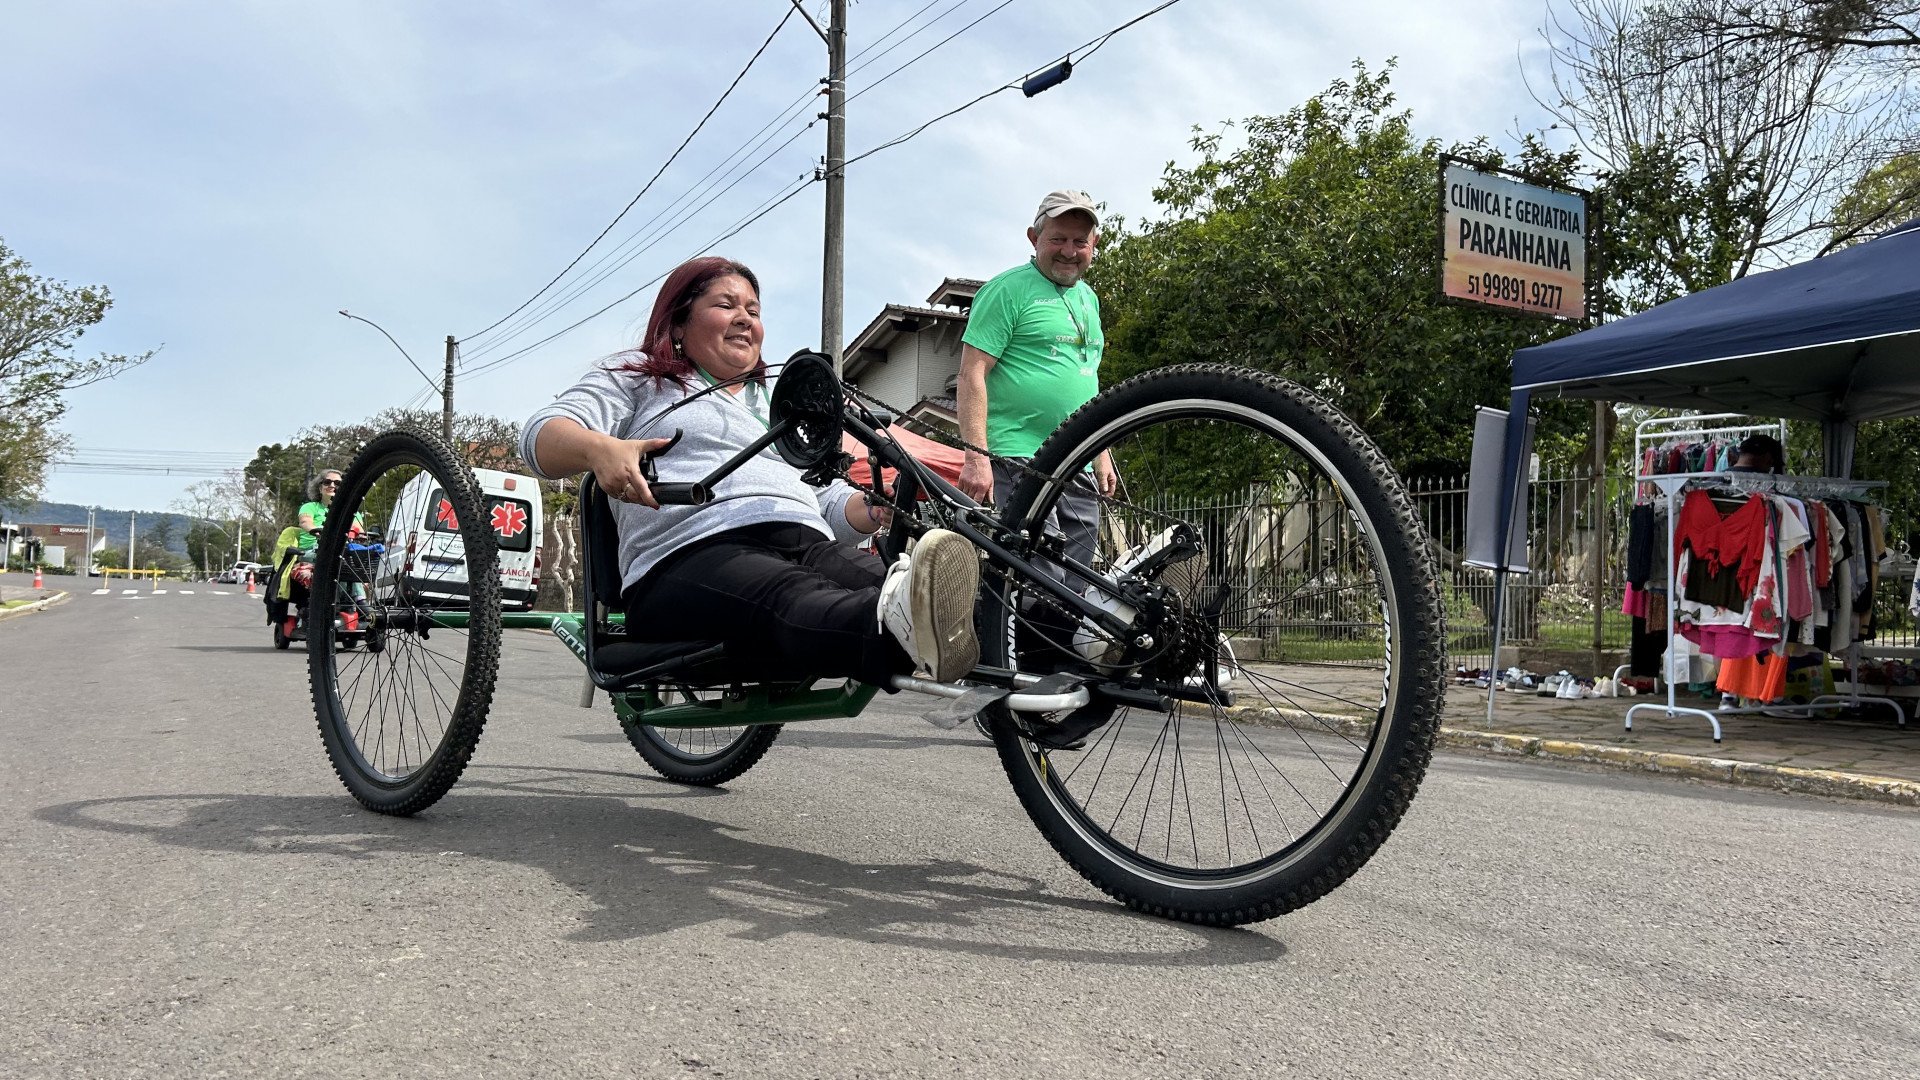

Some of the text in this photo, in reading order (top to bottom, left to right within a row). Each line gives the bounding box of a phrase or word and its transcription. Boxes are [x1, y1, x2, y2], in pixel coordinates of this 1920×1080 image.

[1451, 183, 1580, 235] CLÍNICA E GERIATRIA
[1459, 217, 1571, 271] PARANHANA
[1468, 271, 1562, 310] 51 99891.9277
[499, 566, 531, 578] LÂNCIA
